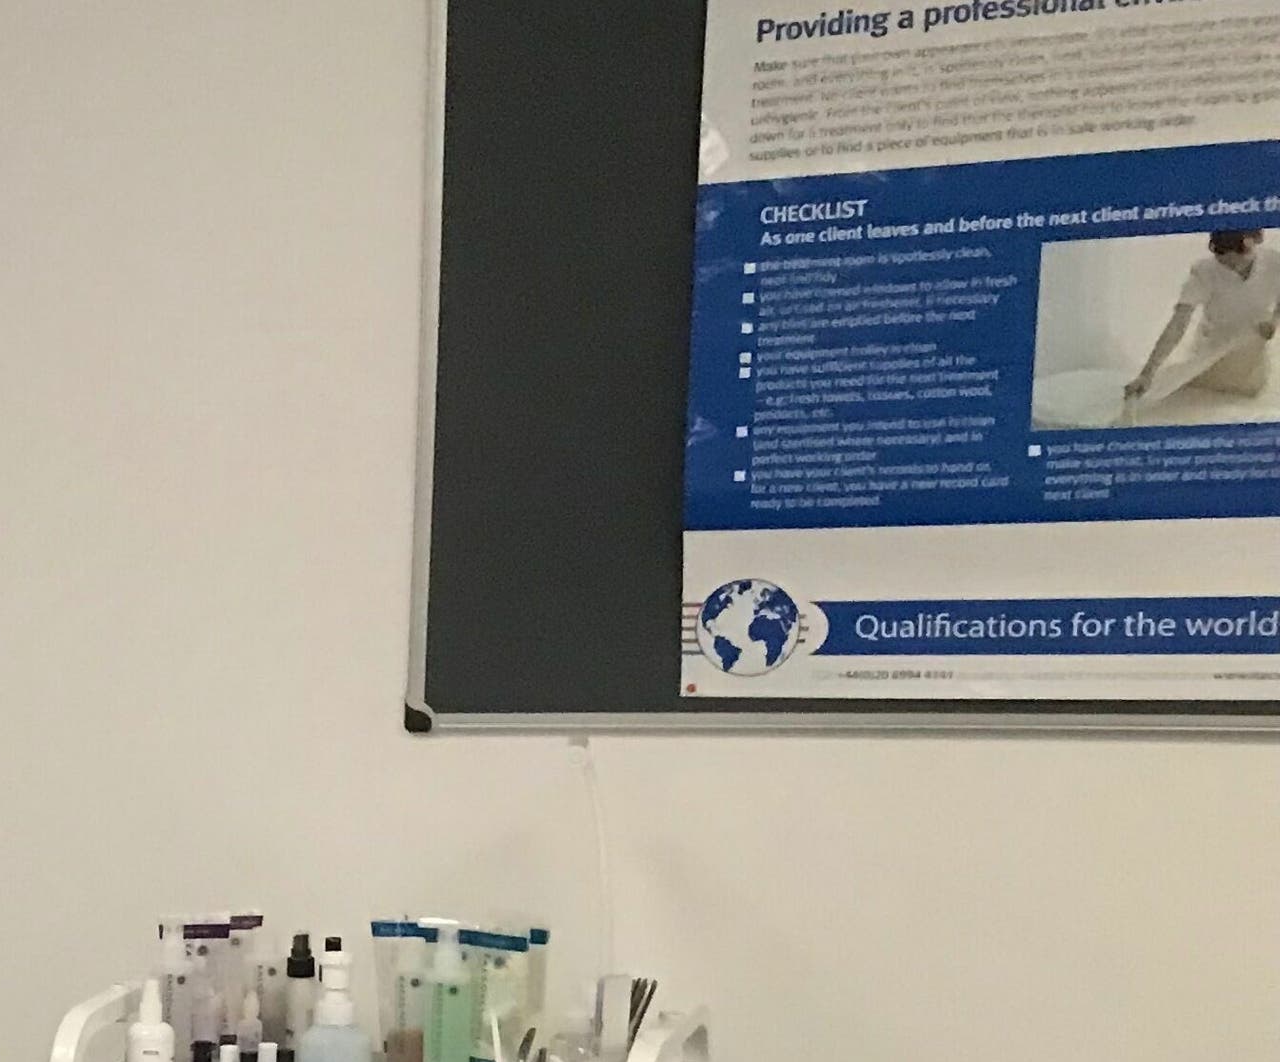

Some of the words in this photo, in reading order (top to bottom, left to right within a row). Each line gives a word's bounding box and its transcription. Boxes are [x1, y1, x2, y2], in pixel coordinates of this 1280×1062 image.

[757, 10, 891, 43] Providing
[898, 10, 914, 30] a
[754, 59, 786, 72] Make
[760, 199, 869, 225] CHECKLIST
[760, 232, 781, 247] As
[785, 232, 815, 245] one
[819, 225, 863, 243] client
[867, 222, 920, 239] leaves
[924, 218, 954, 235] and
[958, 214, 1013, 232] before
[1017, 212, 1045, 229] the
[1049, 210, 1088, 226] next
[1092, 205, 1139, 223] client
[1144, 202, 1204, 220] arrives
[1207, 198, 1260, 216] check
[855, 612, 1062, 641] Qualifications
[1072, 612, 1116, 637] for
[1124, 612, 1176, 637] the
[1186, 610, 1279, 636] world
